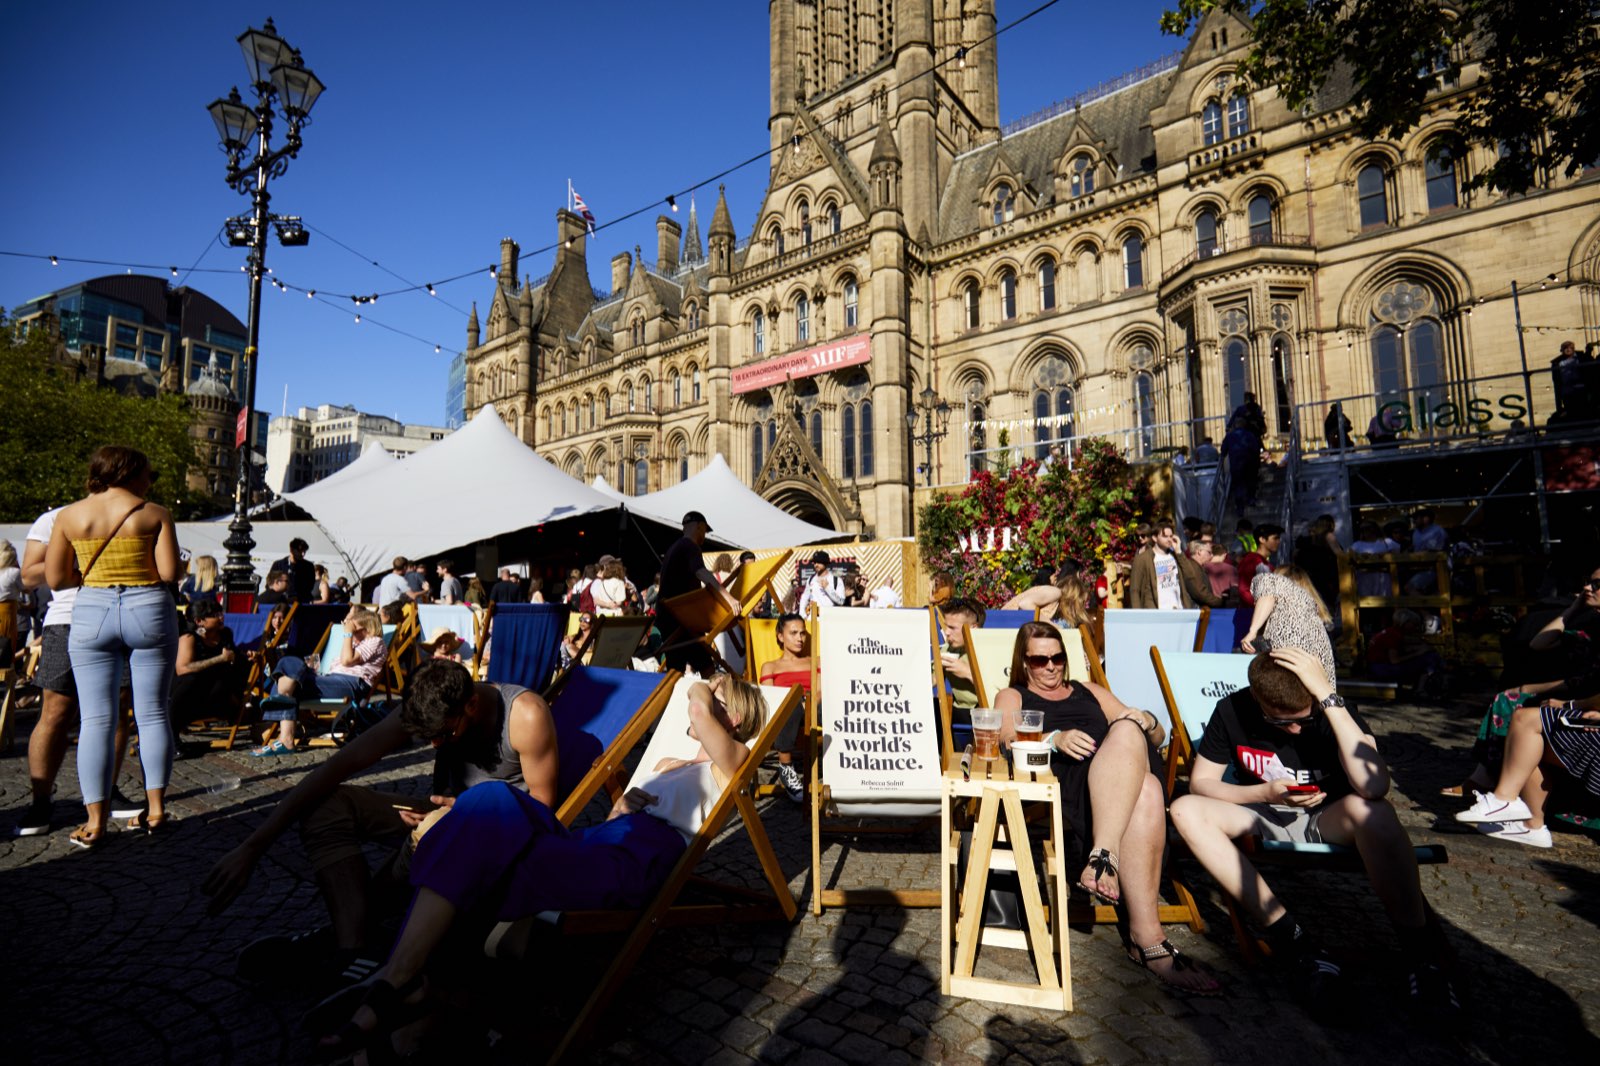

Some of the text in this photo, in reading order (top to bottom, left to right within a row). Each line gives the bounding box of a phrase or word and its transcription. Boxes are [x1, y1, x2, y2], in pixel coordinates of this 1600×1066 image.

[811, 346, 847, 369] MIF
[742, 361, 790, 380] EXTRAORDINARY
[790, 356, 808, 367] DAYS
[1377, 393, 1528, 433] Glass
[847, 643, 903, 656] Guardian
[858, 637, 881, 648] The
[850, 679, 903, 700] Every
[1210, 680, 1238, 692] The
[844, 699, 911, 716] protest
[833, 716, 923, 735] shifts the
[844, 736, 912, 753] world's
[839, 752, 923, 771] balance.
[861, 779, 905, 787] Rebecca Solnit
